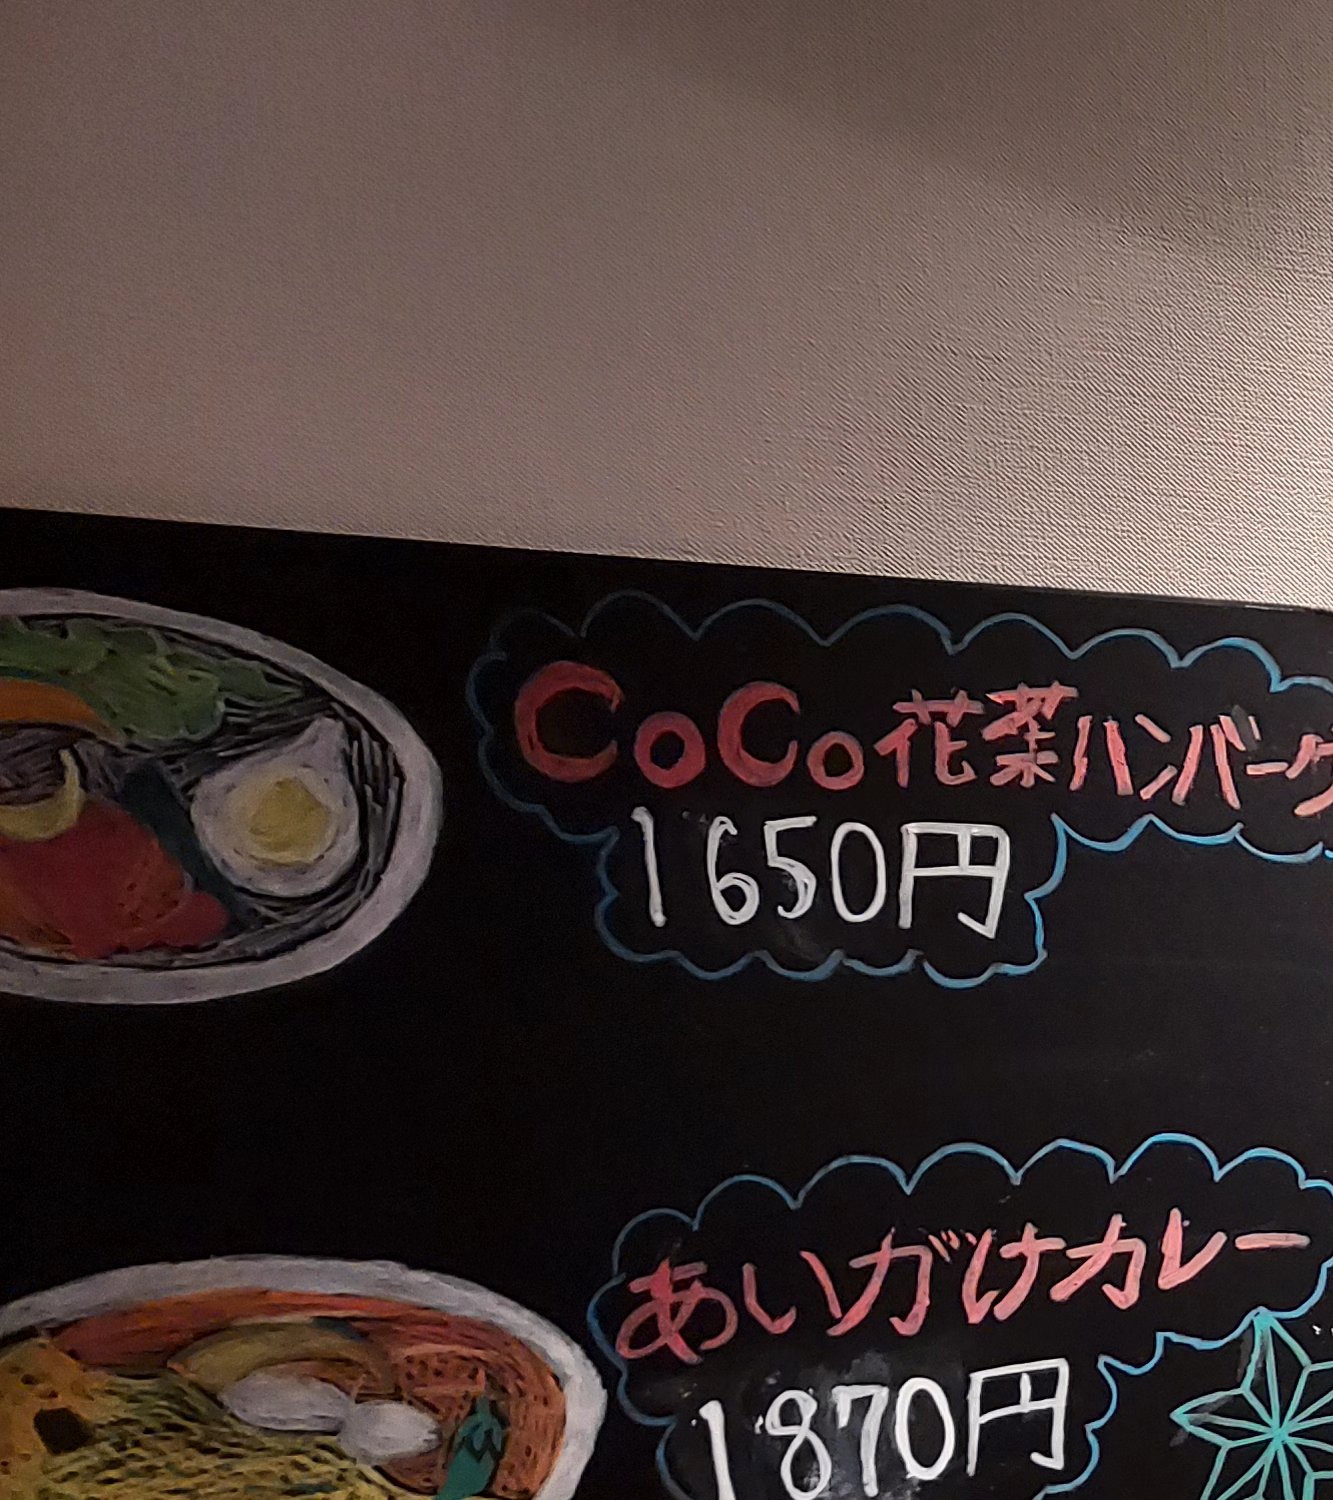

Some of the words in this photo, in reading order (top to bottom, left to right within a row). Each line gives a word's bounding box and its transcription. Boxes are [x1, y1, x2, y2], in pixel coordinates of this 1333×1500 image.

[630, 806, 1010, 938] 1650円
[616, 1207, 1311, 1364] あいがけカレー
